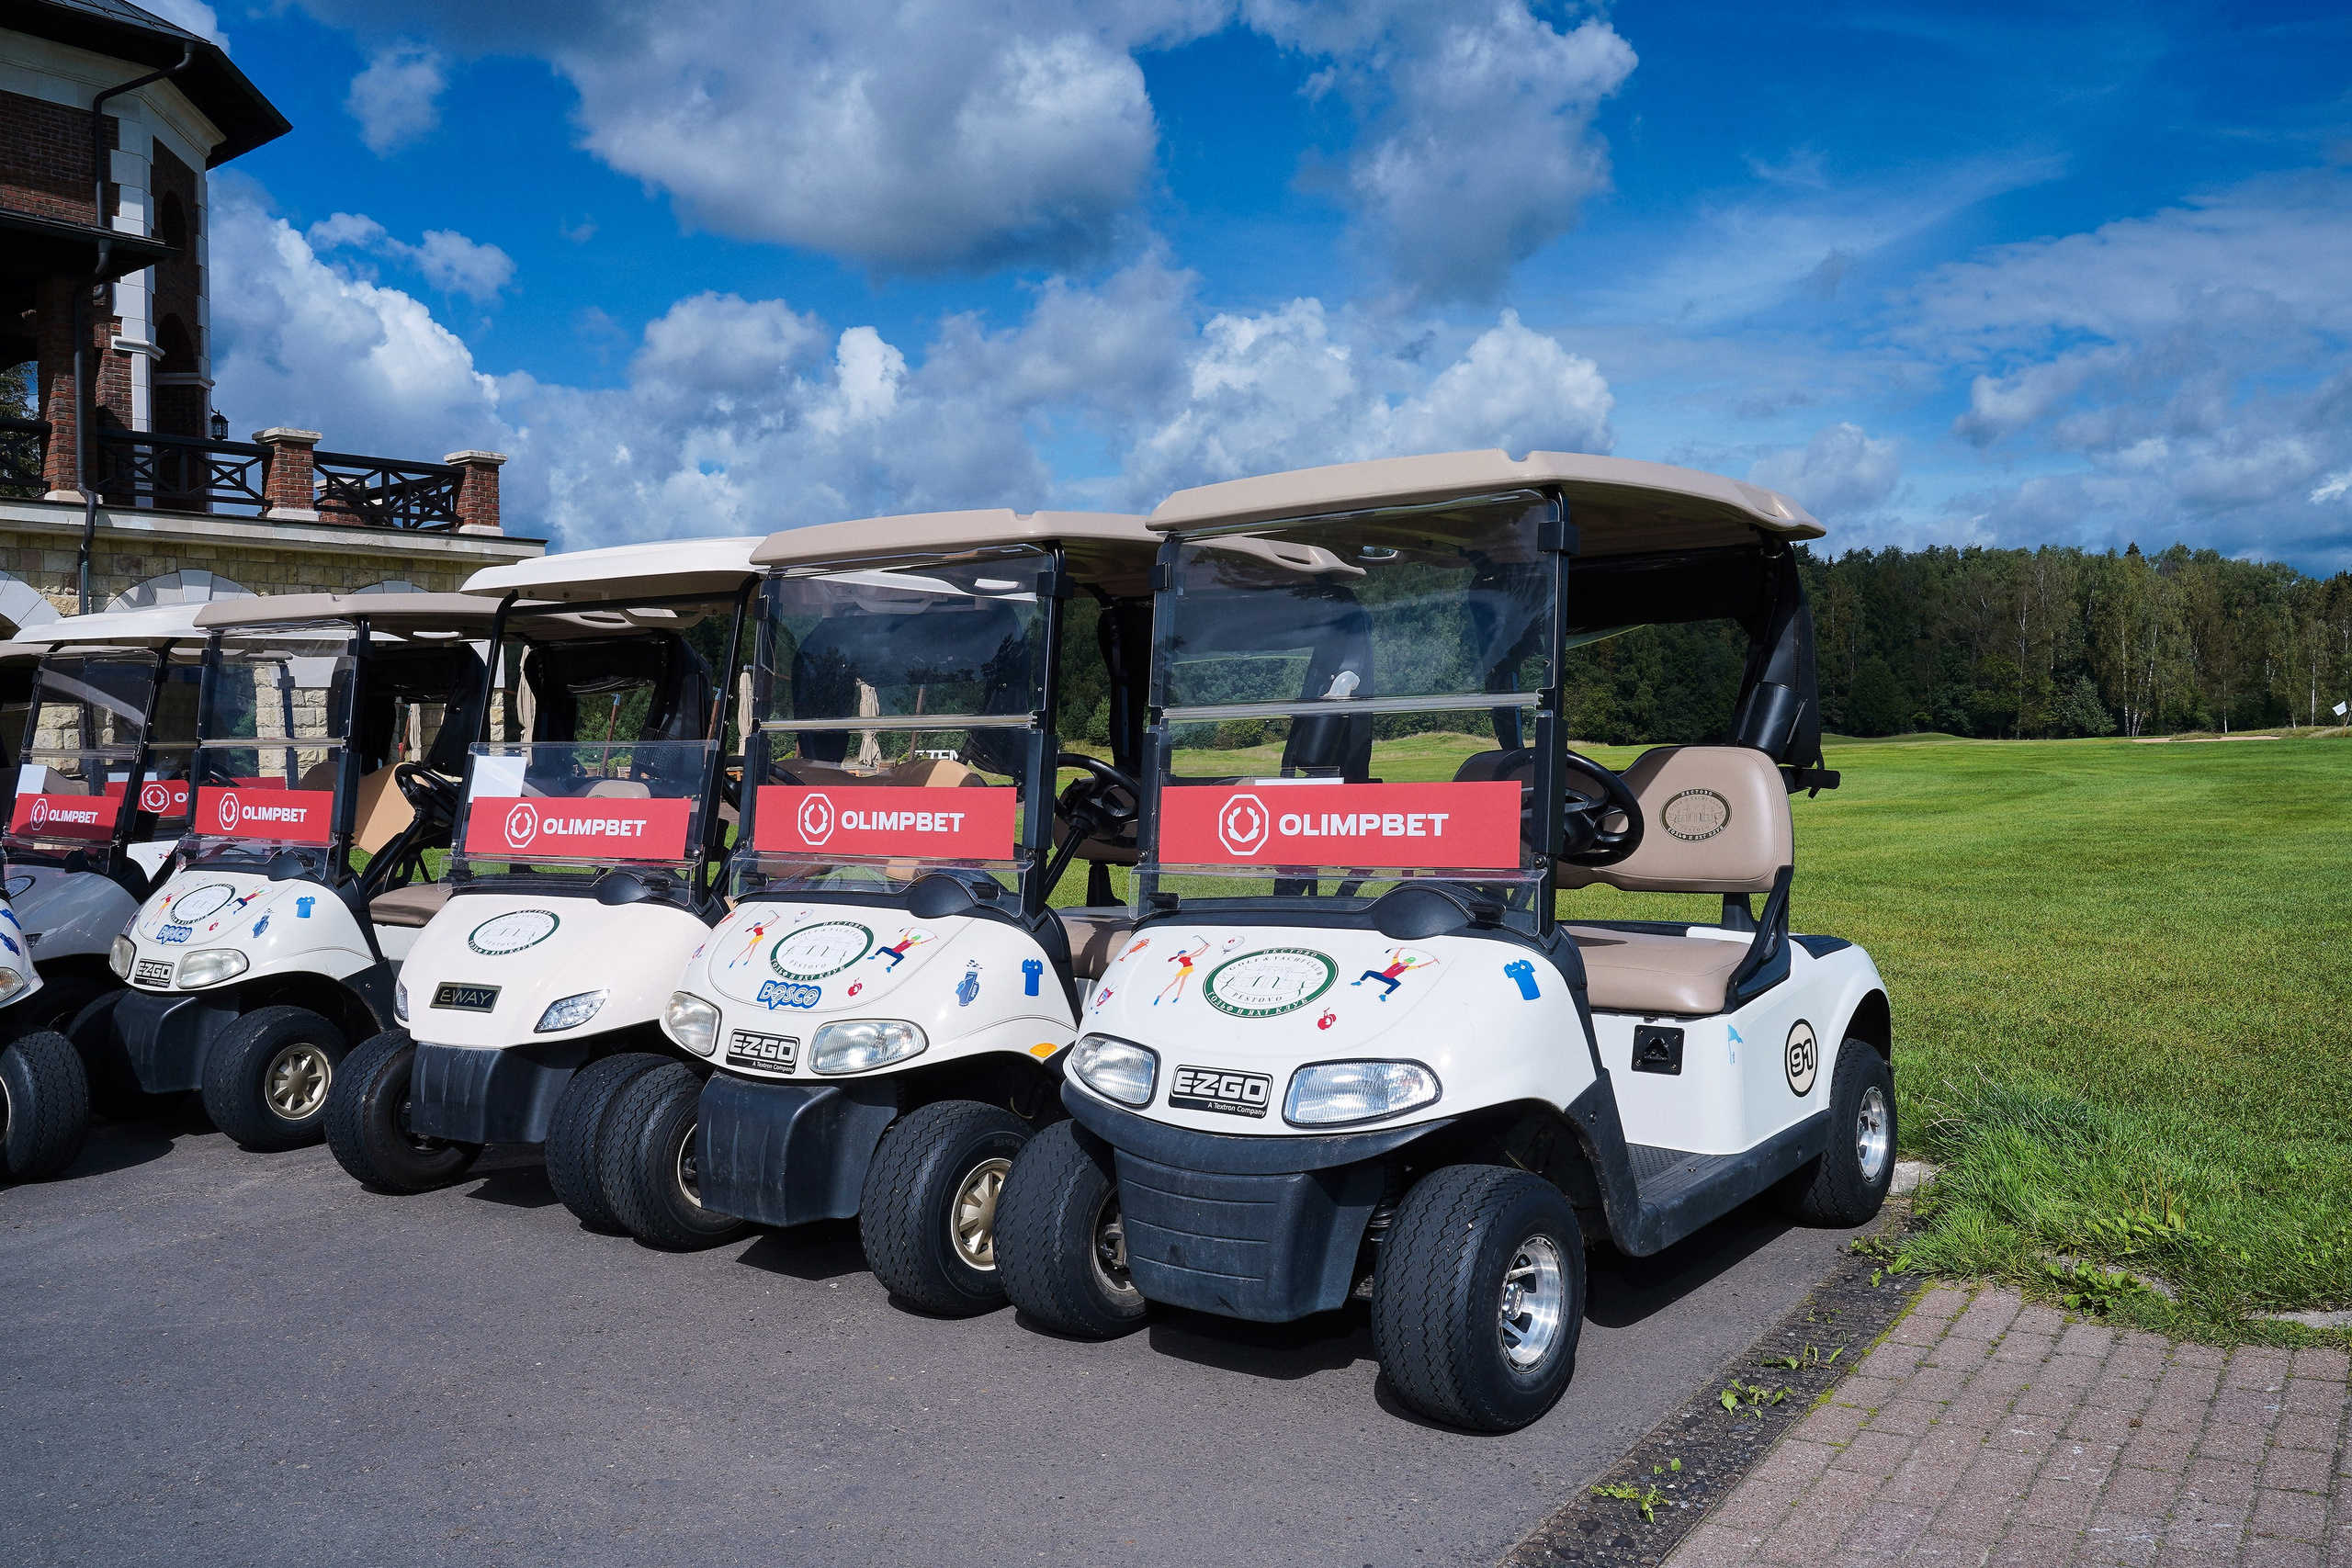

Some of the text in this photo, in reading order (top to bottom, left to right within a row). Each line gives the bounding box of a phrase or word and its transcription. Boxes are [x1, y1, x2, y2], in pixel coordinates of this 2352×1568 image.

[49, 808, 98, 824] OLIMPBET
[242, 806, 308, 823] OLIMPBET
[841, 810, 966, 832] OLIMPBET
[542, 818, 648, 837] OLIMPBET
[1278, 813, 1450, 837] OLIMPBET
[440, 989, 492, 1005] EWAY
[758, 981, 820, 1008] BOSCO
[1207, 991, 1233, 1011] ГОЛЬФ
[1232, 992, 1283, 1003] PESTOVO
[1790, 1038, 1814, 1077] 91
[773, 1064, 795, 1073] Company
[1214, 1102, 1236, 1111] Textron
[1237, 1105, 1267, 1117] Company
